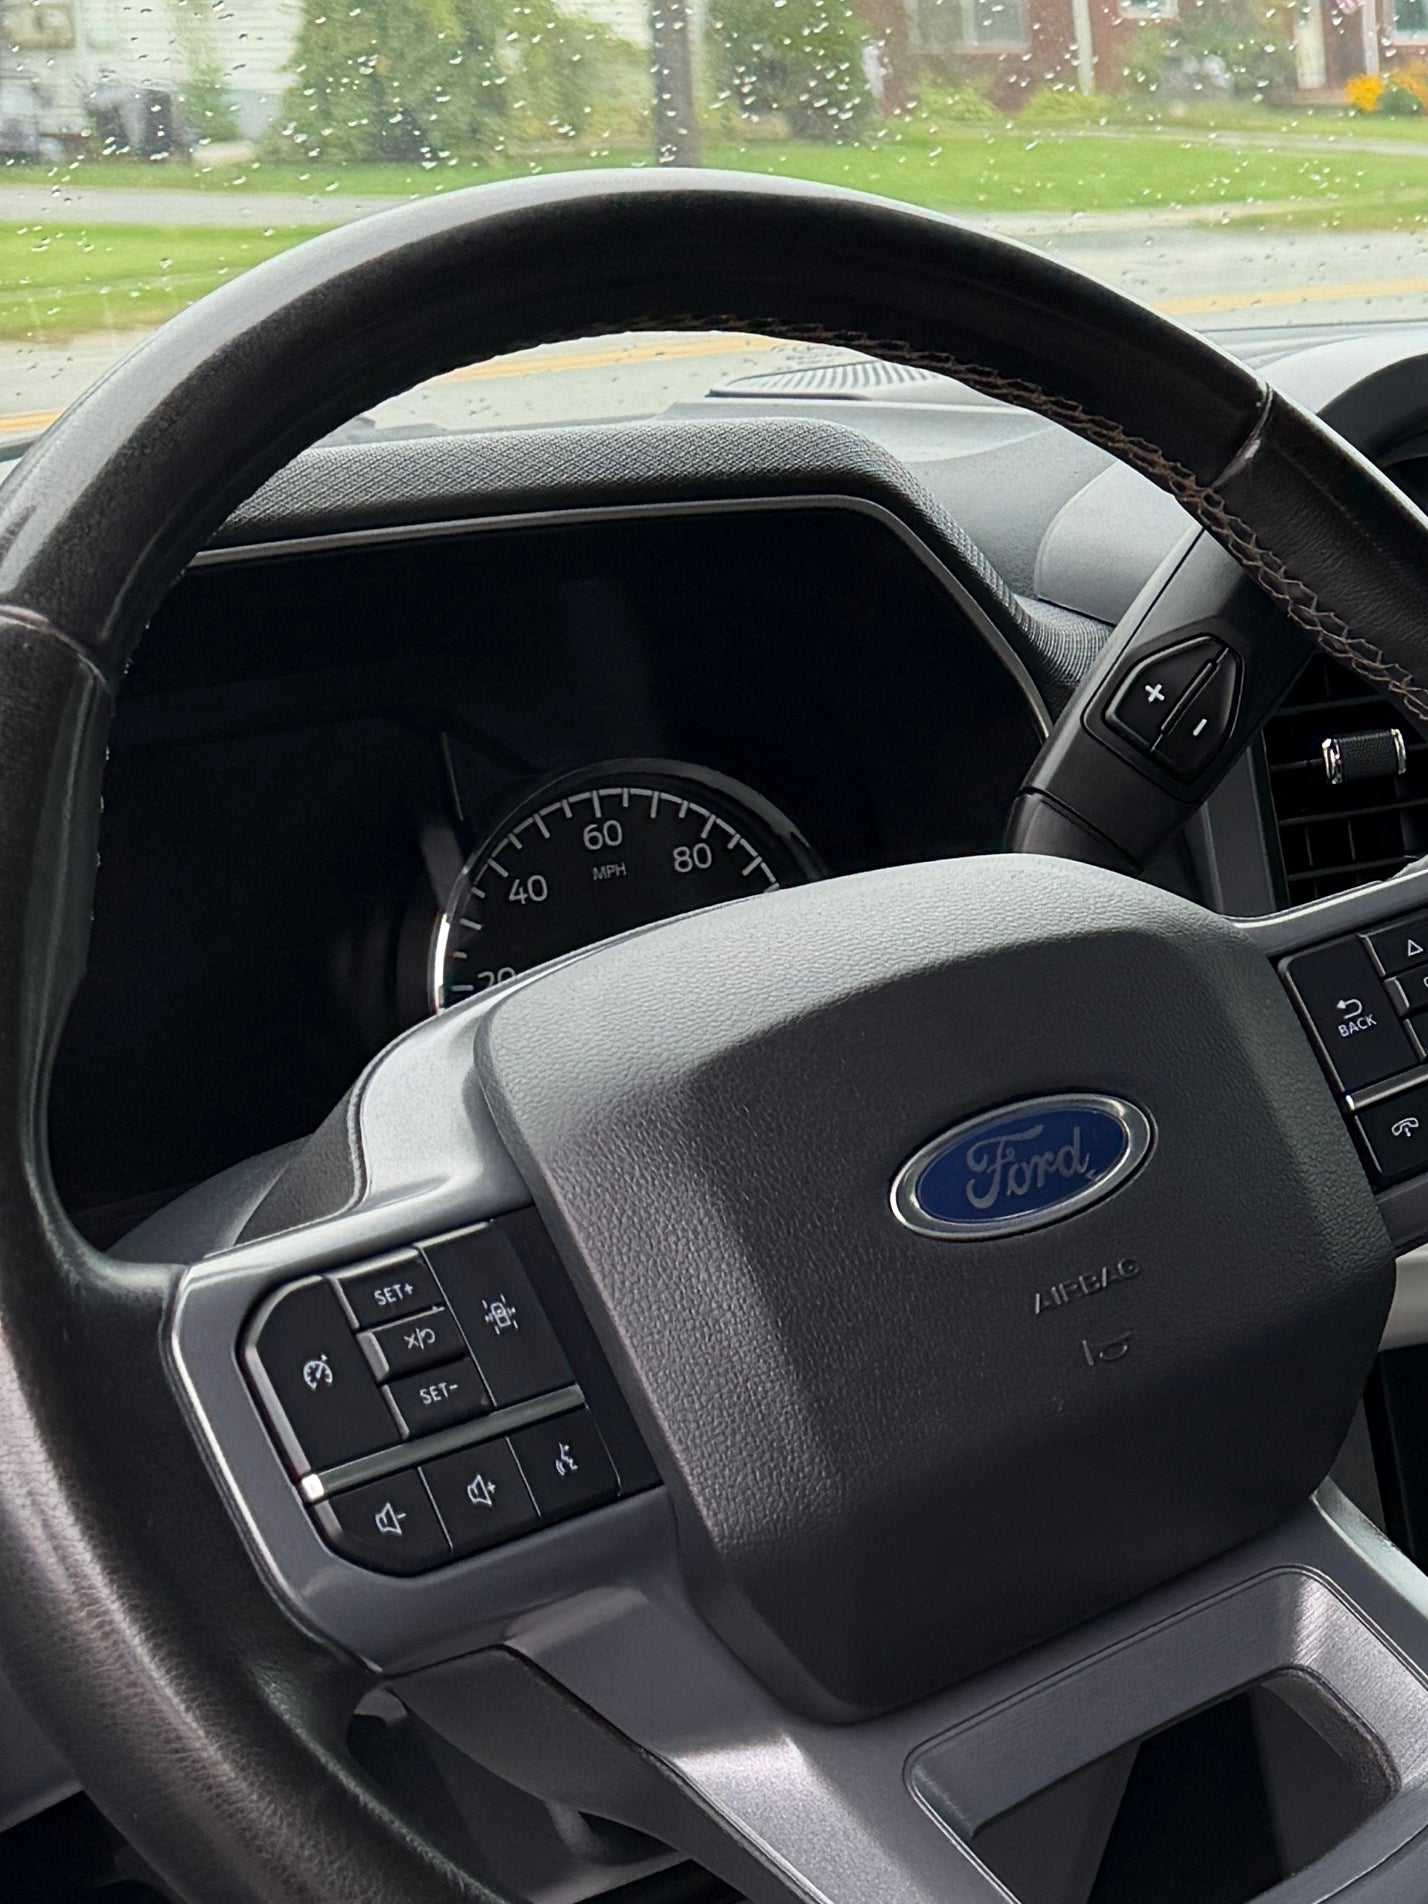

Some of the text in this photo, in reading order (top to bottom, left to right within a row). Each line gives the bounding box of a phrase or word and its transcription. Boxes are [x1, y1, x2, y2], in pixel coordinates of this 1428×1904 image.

[583, 820, 623, 850] 60
[592, 862, 627, 881] MPH
[673, 843, 712, 873] 80
[508, 875, 548, 905] 40
[1337, 1013, 1378, 1038] BACK
[965, 1123, 1099, 1209] Ford
[374, 1281, 414, 1306] SET+
